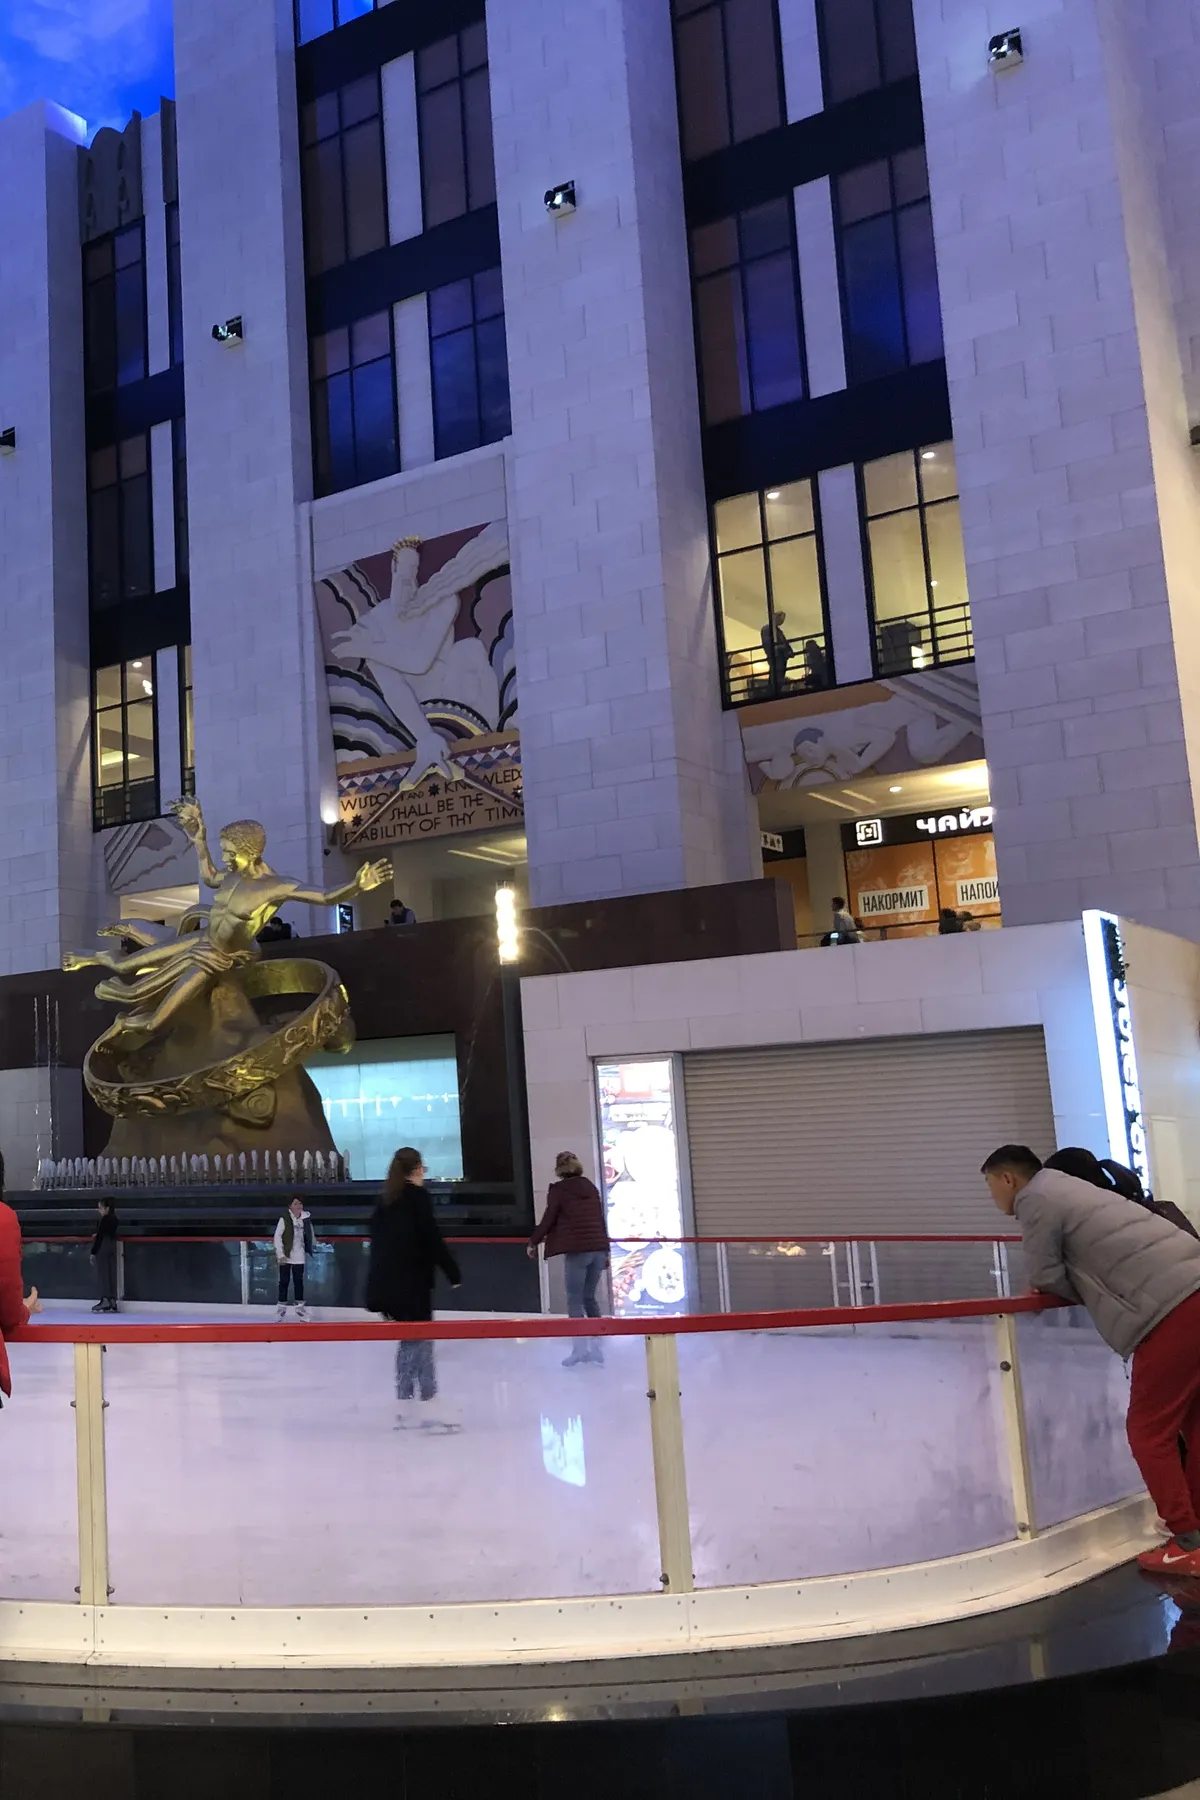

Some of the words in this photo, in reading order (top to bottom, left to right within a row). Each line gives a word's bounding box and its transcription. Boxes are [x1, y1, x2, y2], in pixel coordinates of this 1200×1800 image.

[390, 802, 434, 821] SHALL
[437, 798, 454, 813] BE
[460, 793, 484, 809] THE
[408, 790, 424, 800] AND
[419, 817, 441, 834] OF
[447, 810, 476, 828] THY
[485, 806, 524, 822] TIM
[862, 889, 924, 913] НАКОРМИТ
